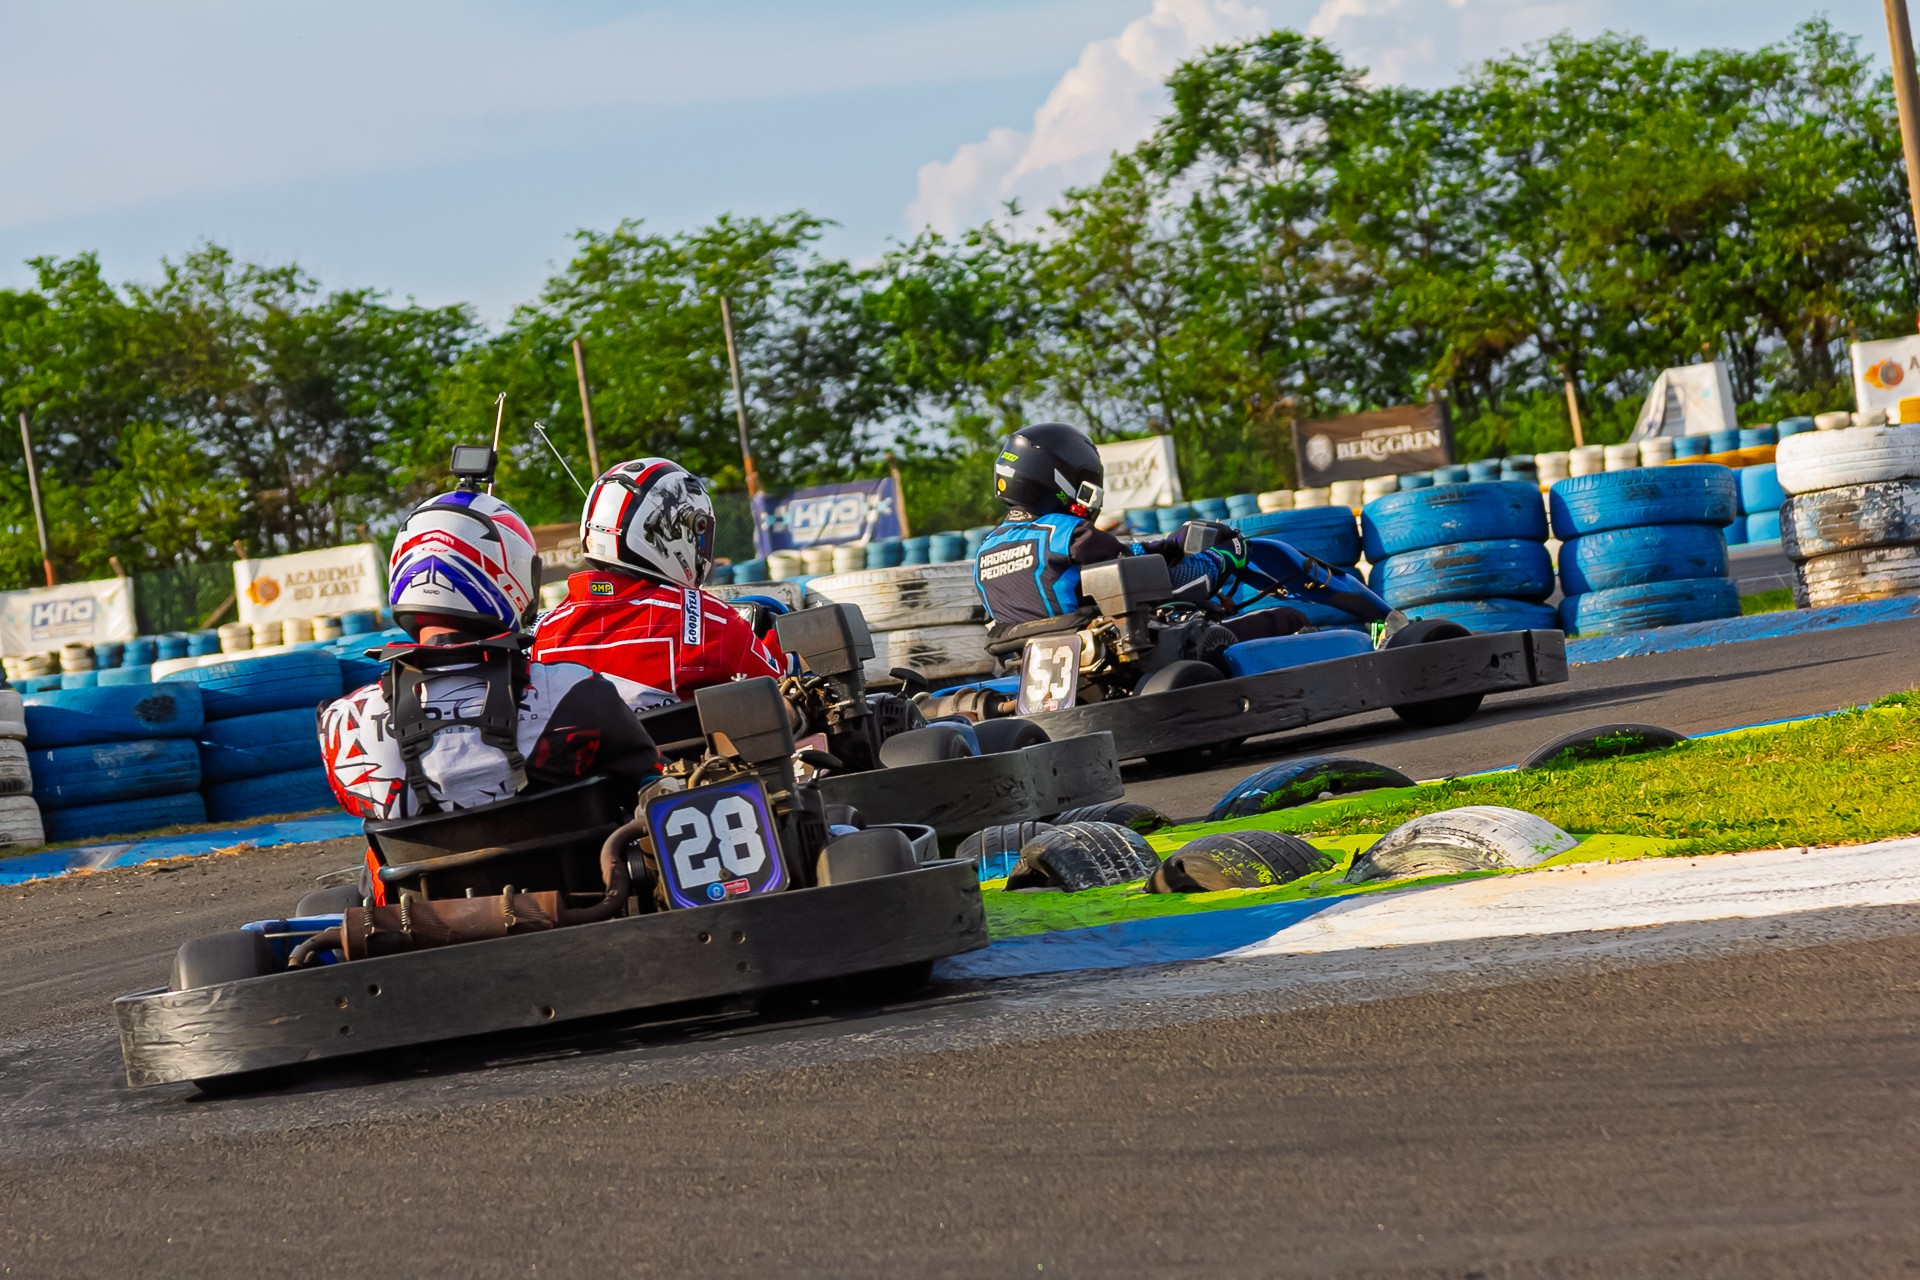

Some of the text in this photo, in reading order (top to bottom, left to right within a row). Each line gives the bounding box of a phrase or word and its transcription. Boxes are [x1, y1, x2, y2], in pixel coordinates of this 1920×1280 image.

[1337, 429, 1441, 463] BERGGREN
[980, 543, 1032, 568] HADRIAN
[980, 555, 1034, 582] PEDROSO
[284, 562, 367, 588] ACADEMIA
[591, 583, 613, 594] OMP
[320, 580, 361, 598] KART
[687, 590, 700, 643] GOODYEAR
[1026, 642, 1074, 702] 53
[665, 795, 767, 890] 28
